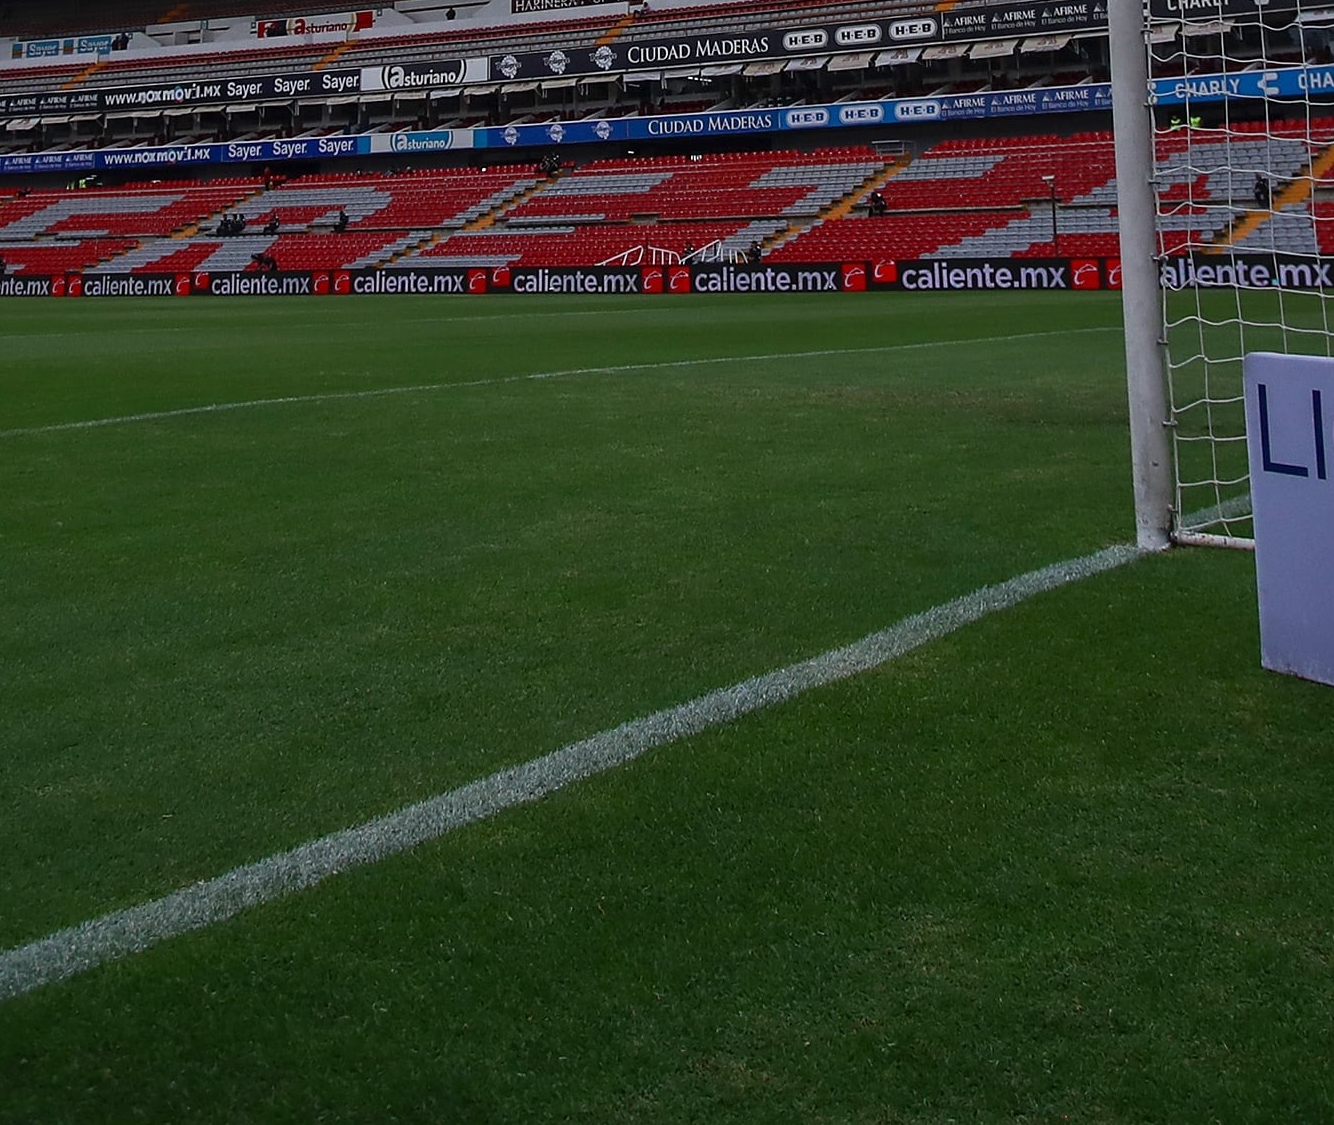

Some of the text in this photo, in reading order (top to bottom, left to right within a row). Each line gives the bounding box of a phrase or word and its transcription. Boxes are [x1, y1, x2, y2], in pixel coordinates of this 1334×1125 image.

[954, 14, 987, 26] AFIRME
[1003, 10, 1036, 22] AFIRME
[1053, 4, 1088, 16] AFIRME
[294, 18, 349, 35] asturiano
[29, 41, 59, 56] Sayer
[80, 38, 110, 53] Sayer
[627, 43, 691, 64] CIUDAD
[695, 36, 769, 58] MADERAS
[388, 65, 457, 89] asturiano
[1003, 93, 1036, 105] AFIRME
[1054, 90, 1089, 101] AFIRME
[1174, 78, 1241, 99] CHARLY
[953, 97, 986, 109] AFIRME
[648, 115, 772, 136] CIUDAD MADERAS
[395, 133, 446, 152] asturiano
[354, 271, 465, 295] caliente.mx
[513, 268, 639, 295] caliente.mx
[695, 265, 839, 293] caliente.mx
[901, 262, 1066, 291] caliente.mx
[1158, 255, 1334, 290] aliente.mx
[83, 275, 173, 297] caliente.mx
[211, 273, 310, 295] caliente.mx
